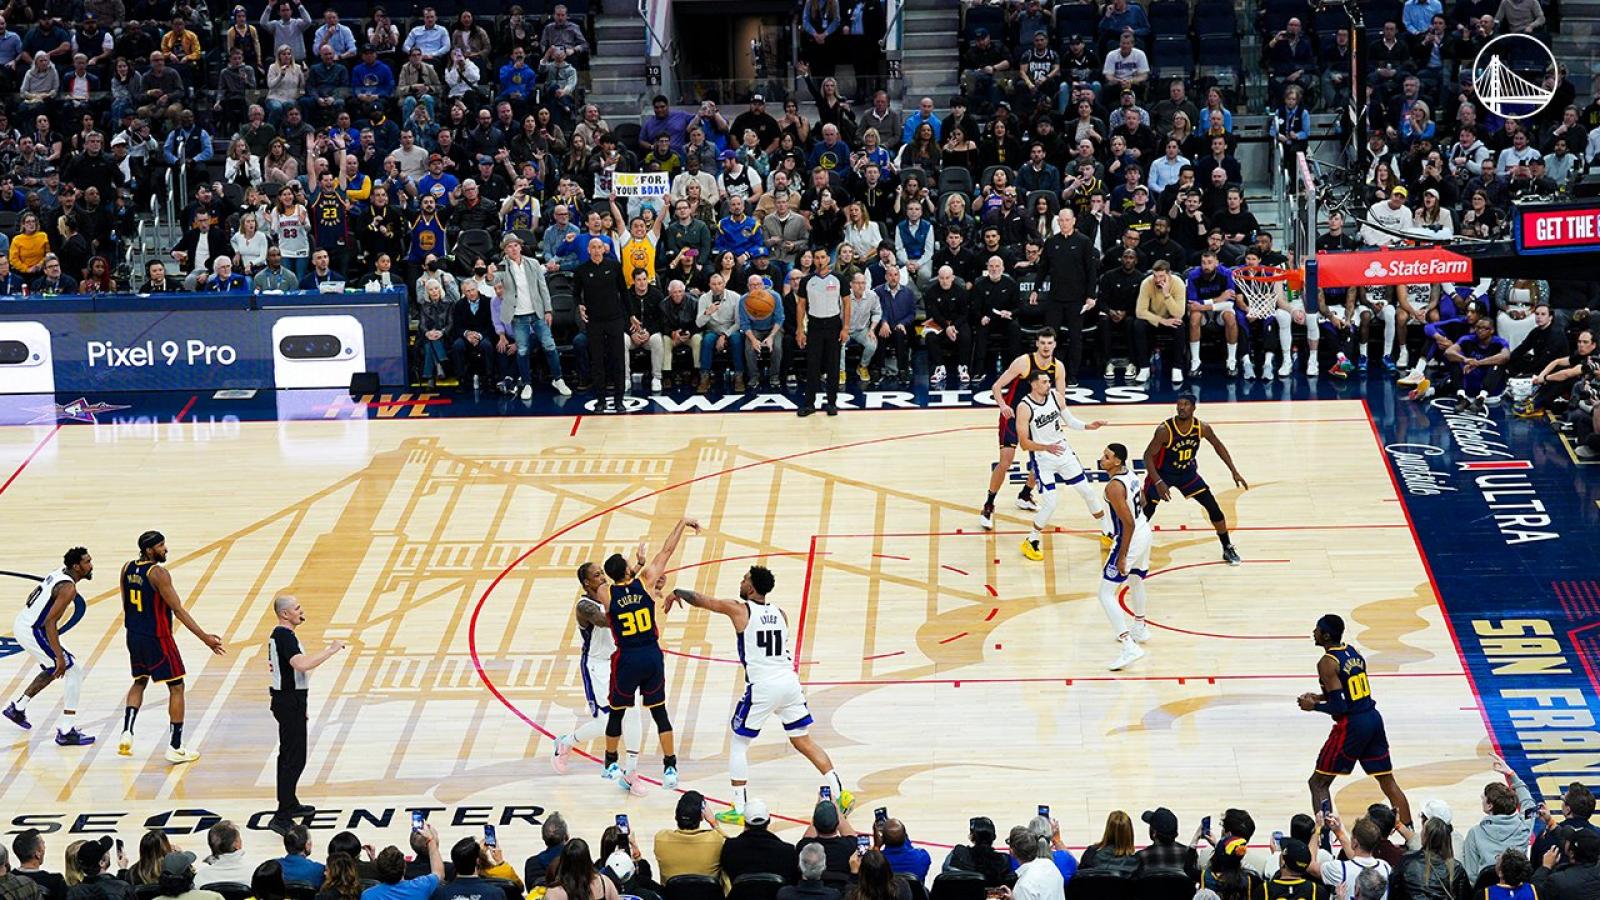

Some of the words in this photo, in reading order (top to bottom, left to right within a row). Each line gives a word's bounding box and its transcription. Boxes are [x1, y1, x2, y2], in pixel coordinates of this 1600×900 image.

[616, 185, 639, 195] YOUR
[322, 208, 338, 219] 23
[283, 228, 298, 239] 23
[1536, 217, 1563, 241] GET
[1565, 215, 1594, 239] THE
[87, 340, 155, 367] Pixel
[160, 340, 179, 366] 9
[186, 339, 237, 366] Pro
[1178, 448, 1193, 461] 10
[1475, 474, 1560, 545] ULTRA
[129, 589, 143, 613] 4
[617, 593, 644, 608] CURRY
[617, 607, 653, 637] 30
[756, 629, 783, 657] 41
[1471, 619, 1573, 676] SAN
[1347, 672, 1372, 702] 00
[246, 805, 545, 830] CENTER
